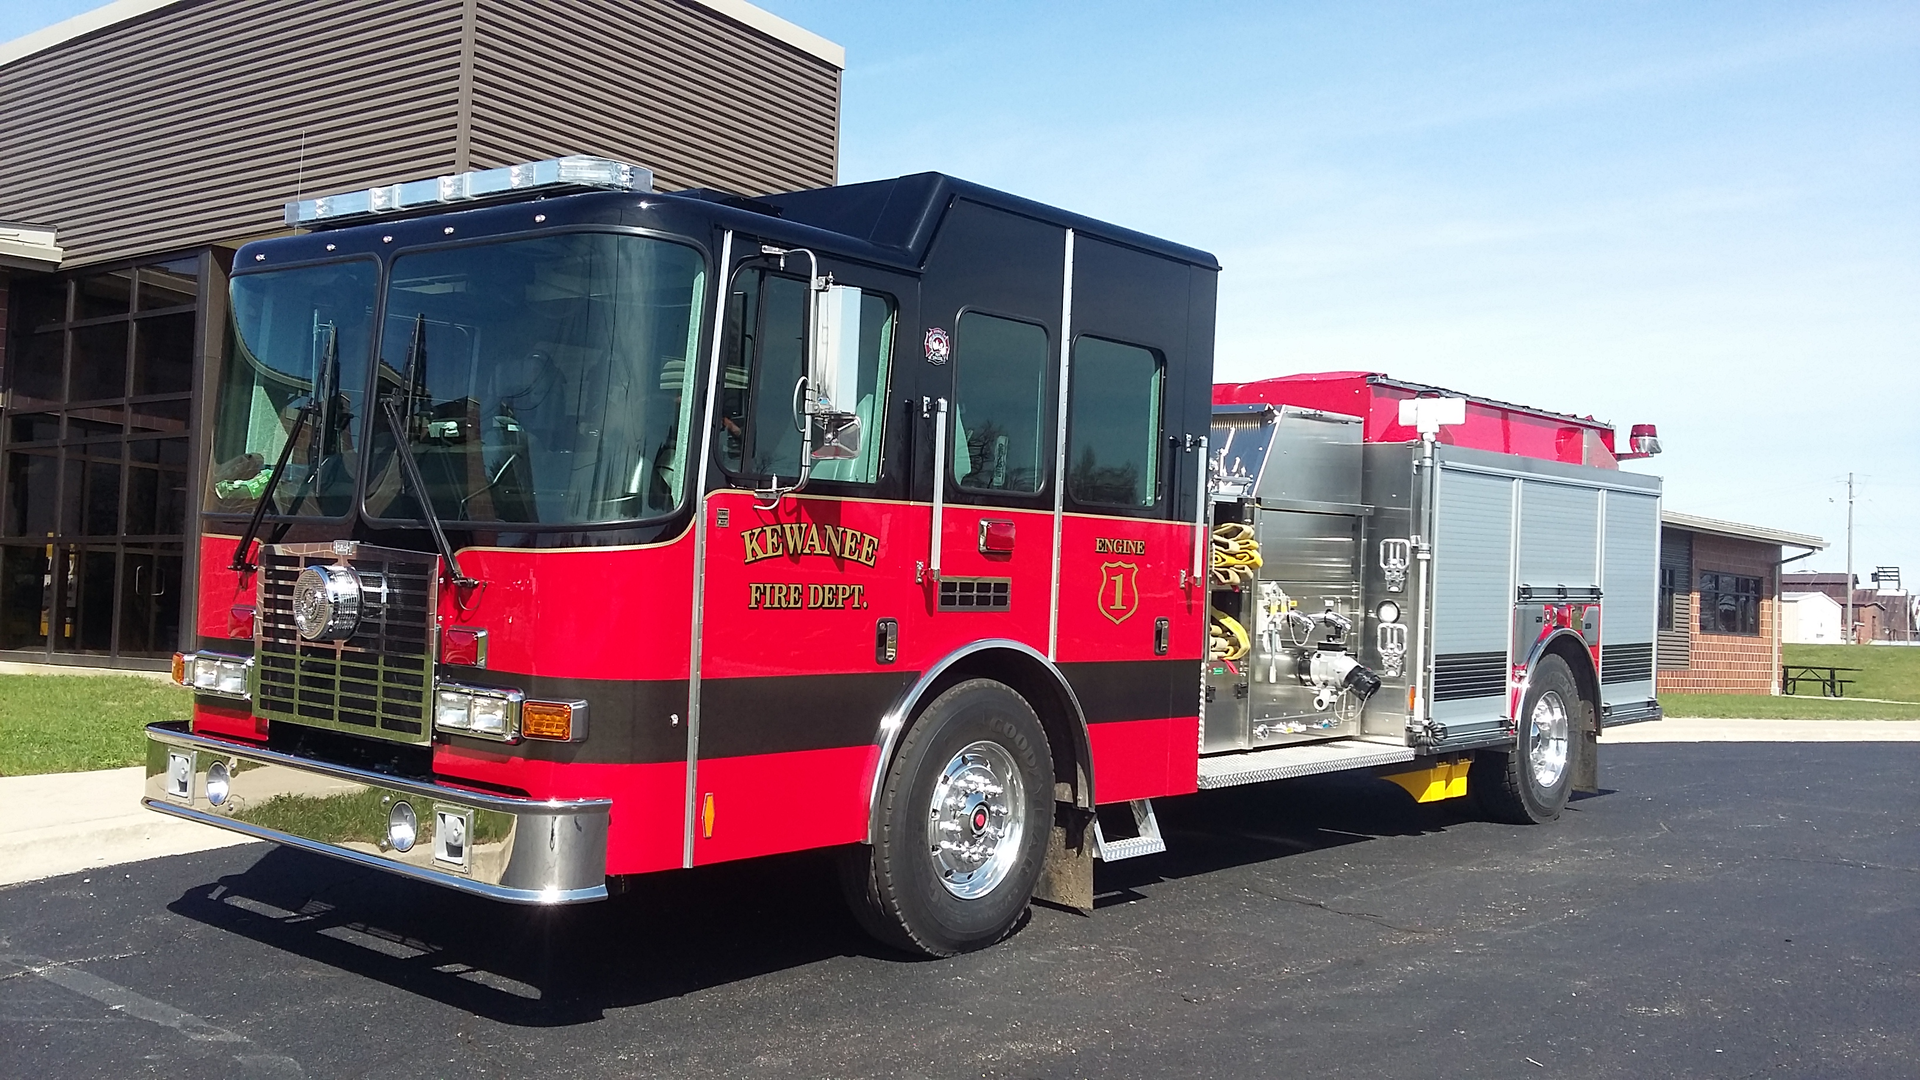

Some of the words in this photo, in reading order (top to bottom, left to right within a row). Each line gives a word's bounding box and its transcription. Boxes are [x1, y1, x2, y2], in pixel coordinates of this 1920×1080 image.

[741, 523, 878, 567] KEWANEE
[1095, 537, 1145, 555] ENGINE
[748, 583, 803, 609] FIRE
[808, 584, 868, 609] DEPT.
[1110, 573, 1126, 610] 1
[989, 717, 1044, 878] GOODYEAR
